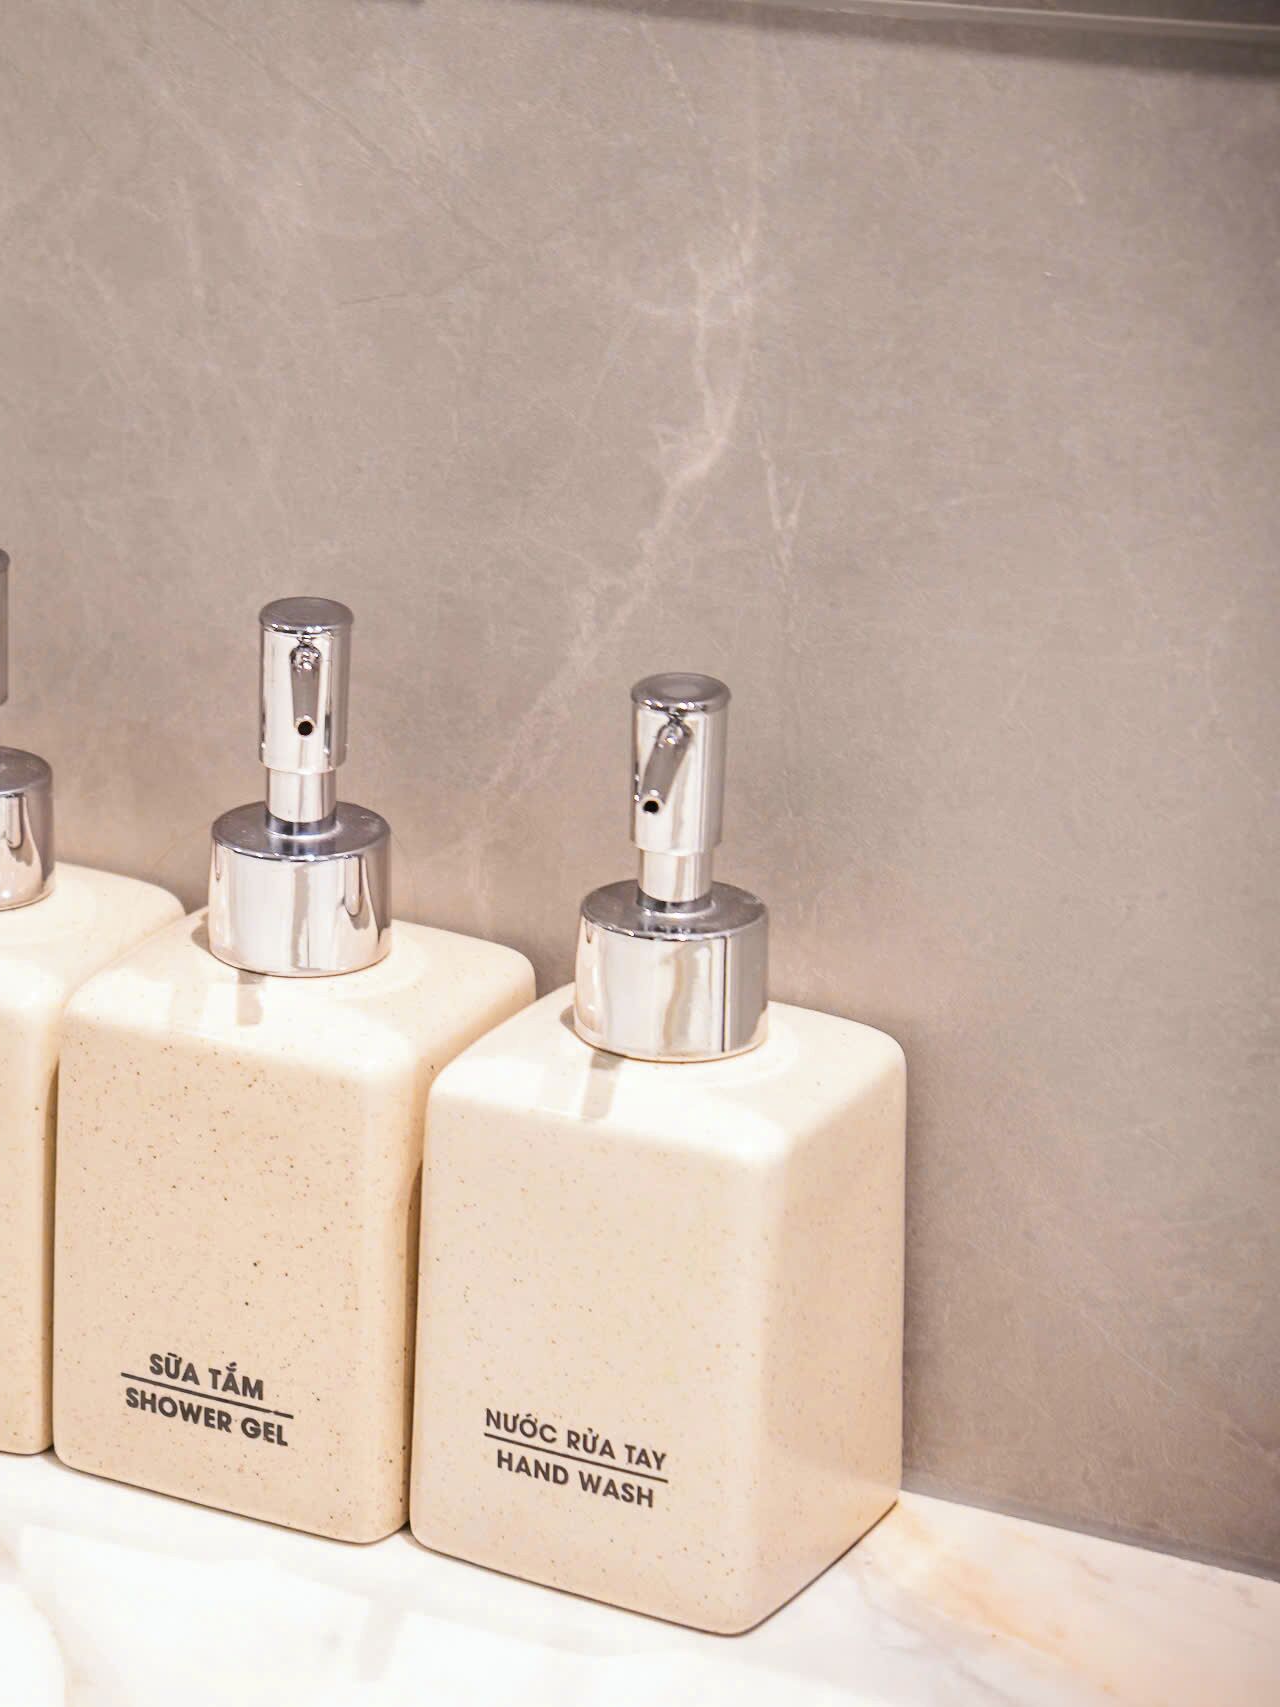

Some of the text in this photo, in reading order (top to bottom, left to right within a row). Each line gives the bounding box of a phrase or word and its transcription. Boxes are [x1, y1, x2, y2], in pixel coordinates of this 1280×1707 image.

[149, 1352, 264, 1400] SỮA TẮM
[125, 1387, 288, 1447] SHOWER GEL
[486, 1408, 666, 1470] NƯỚC RỬA TAY
[497, 1449, 653, 1508] HAND WASH
